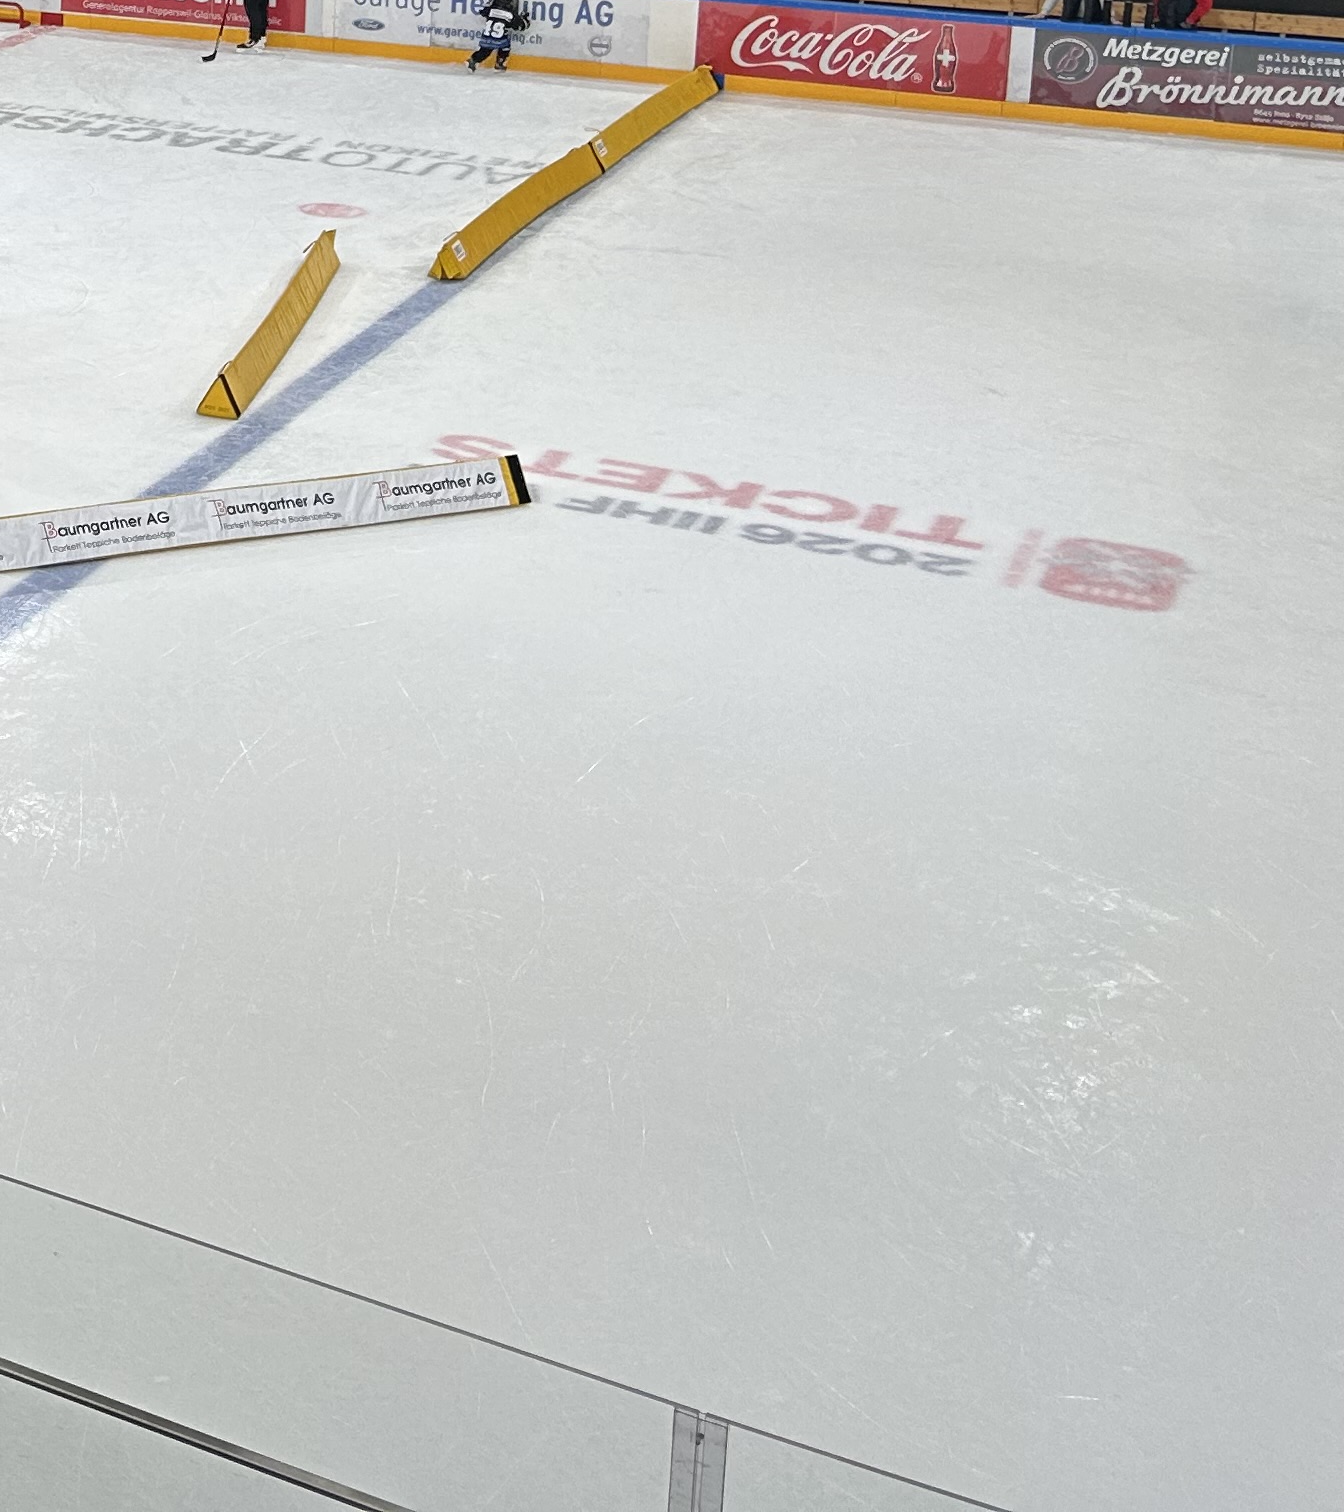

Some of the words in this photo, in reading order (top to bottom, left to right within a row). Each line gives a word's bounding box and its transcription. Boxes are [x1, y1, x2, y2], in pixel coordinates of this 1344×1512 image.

[484, 20, 506, 39] 19
[574, 1, 615, 26] AG
[731, 14, 932, 82] Coca-Cola
[1102, 38, 1230, 68] Metzgerei
[1096, 66, 1344, 109] Brönnimann
[377, 475, 472, 500] Baumgartner
[474, 471, 497, 486] AG
[431, 432, 986, 552] TICKETS
[210, 498, 308, 520] Baumgartner
[312, 492, 336, 507] AG
[554, 495, 730, 536] IIHF
[42, 516, 145, 542] Baumgartner
[147, 510, 171, 525] AG
[741, 522, 977, 577] 2026
